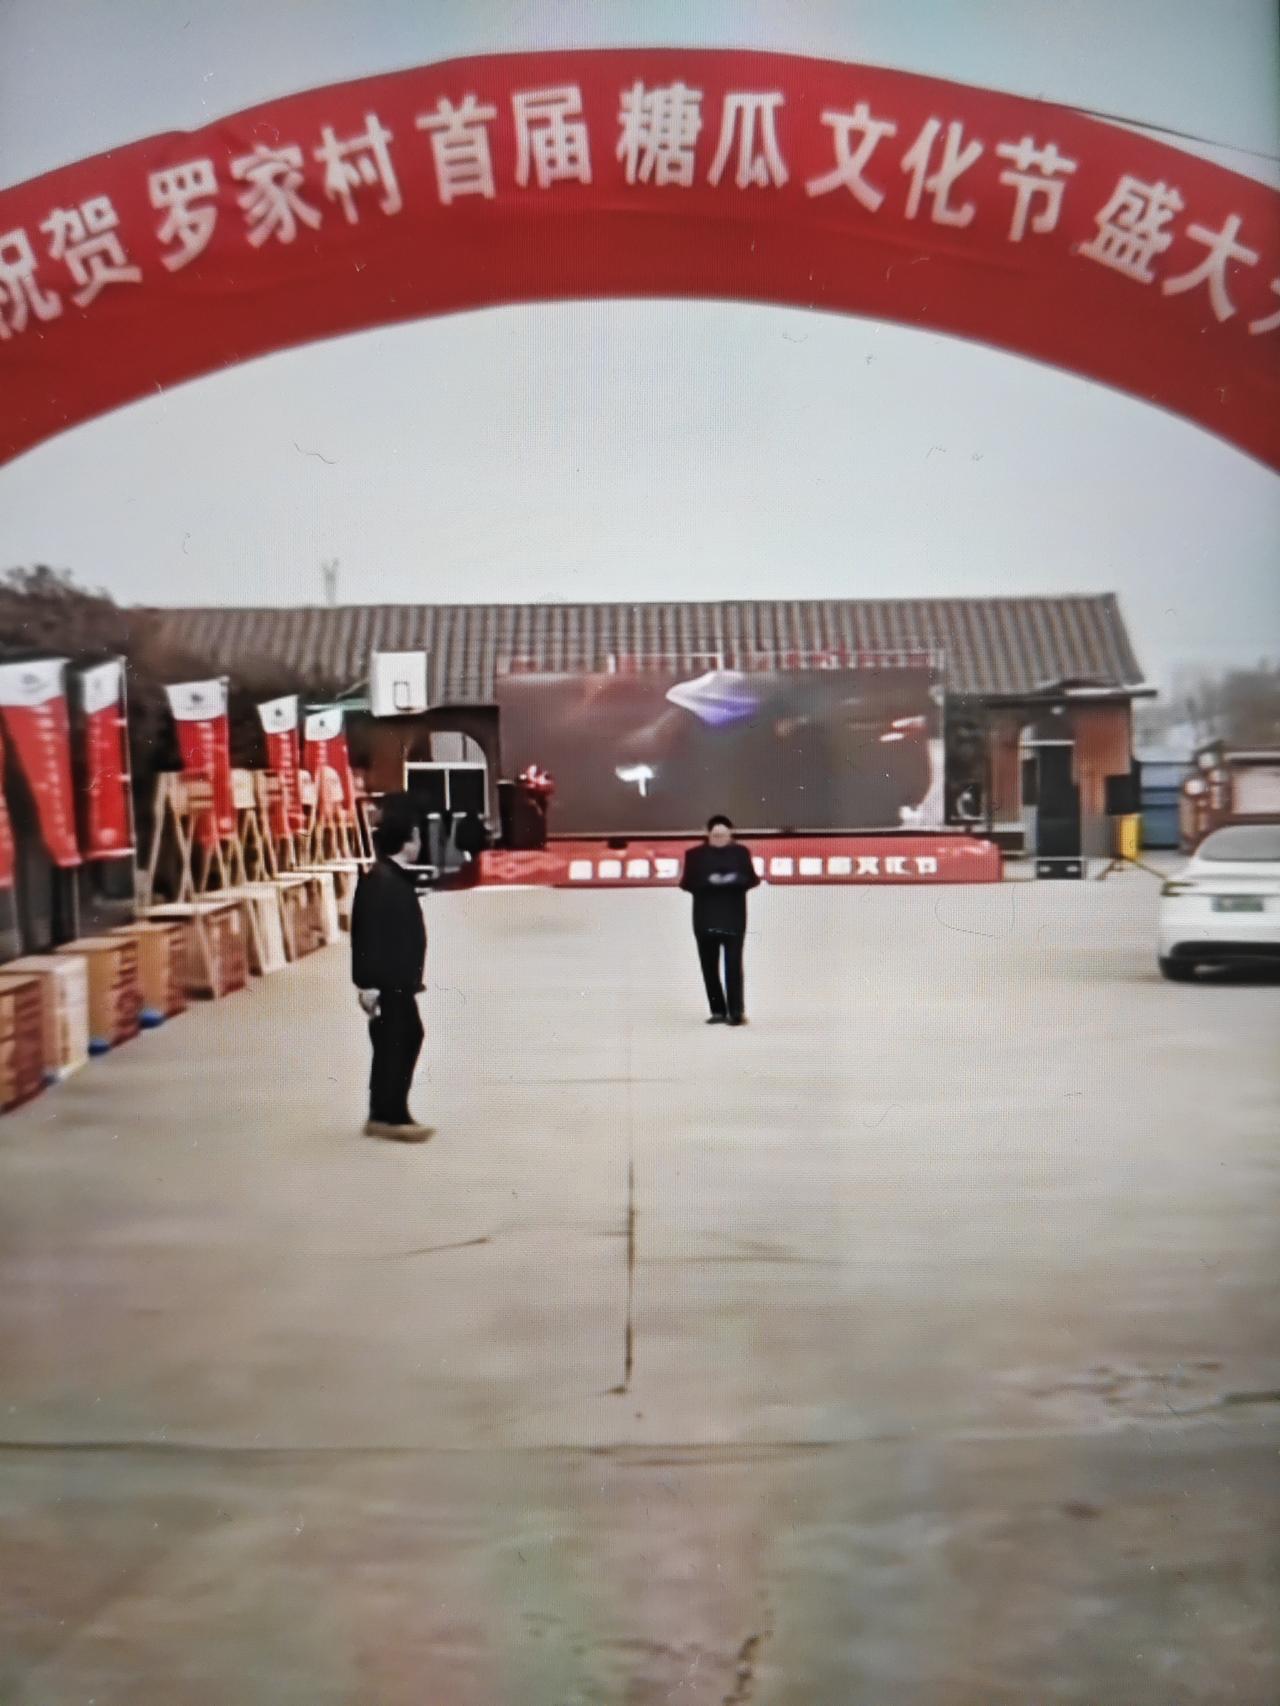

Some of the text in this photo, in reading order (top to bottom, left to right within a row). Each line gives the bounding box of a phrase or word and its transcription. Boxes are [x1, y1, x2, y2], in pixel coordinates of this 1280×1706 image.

[0, 81, 1280, 338] 祝贺罗家村首届糖瓜文化节盛大
